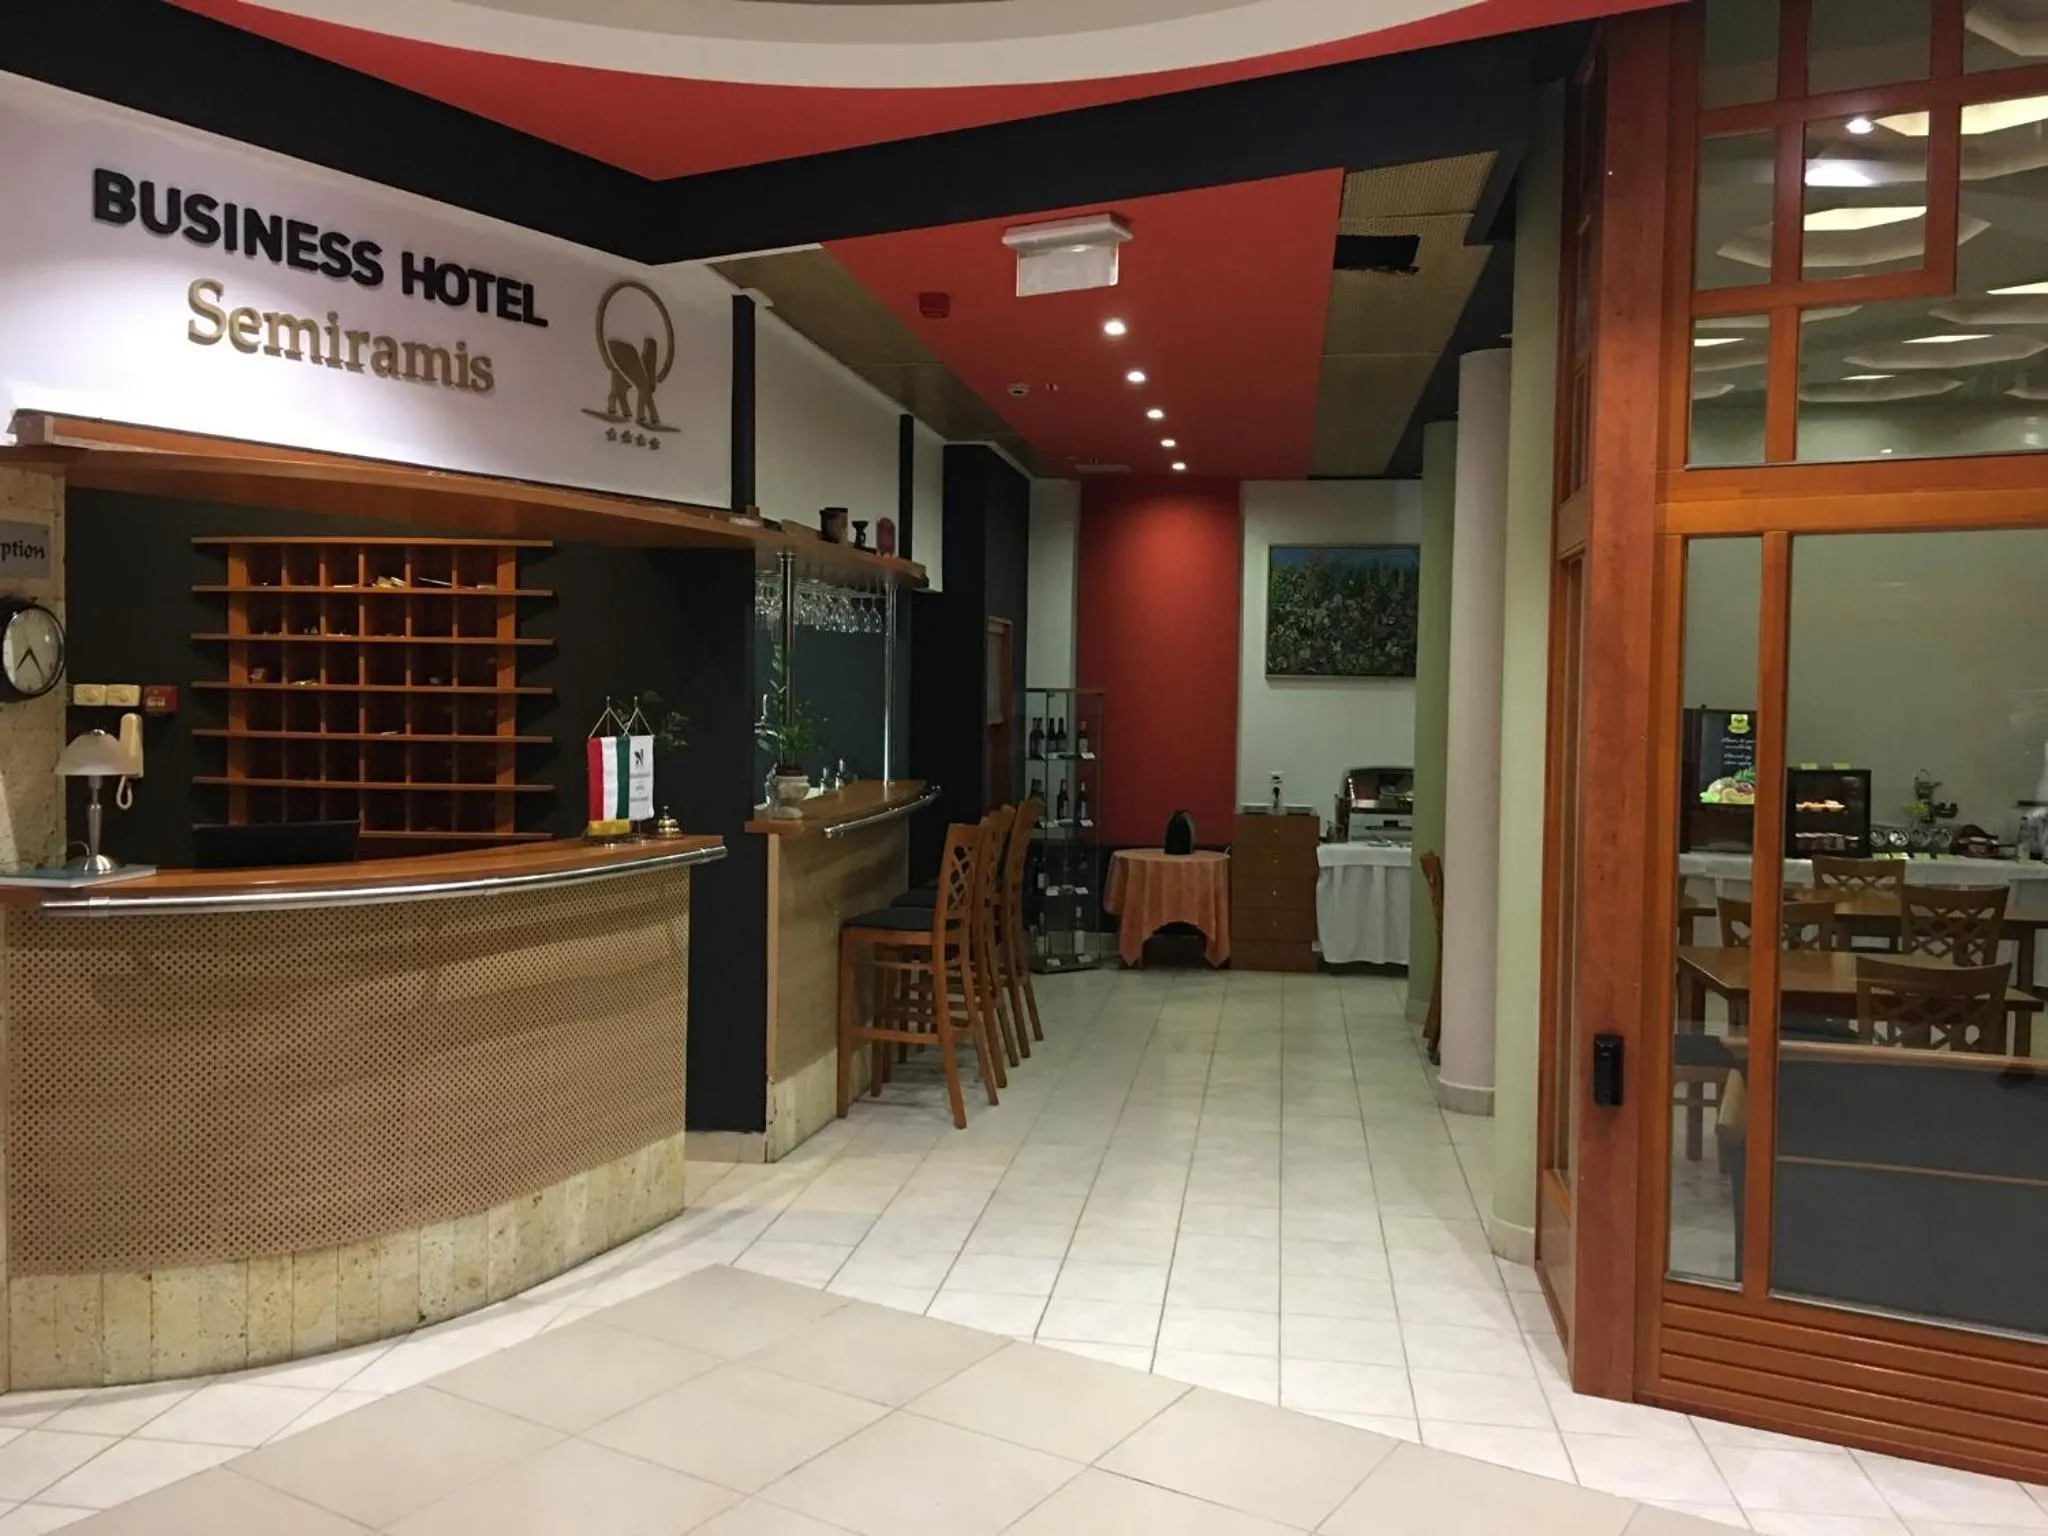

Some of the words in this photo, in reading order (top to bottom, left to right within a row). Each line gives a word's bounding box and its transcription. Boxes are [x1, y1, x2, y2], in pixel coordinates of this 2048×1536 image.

[94, 168, 384, 286] BUSINESS
[401, 251, 549, 328] HOTEL
[188, 277, 494, 392] Semiramis
[0, 540, 45, 562] ption
